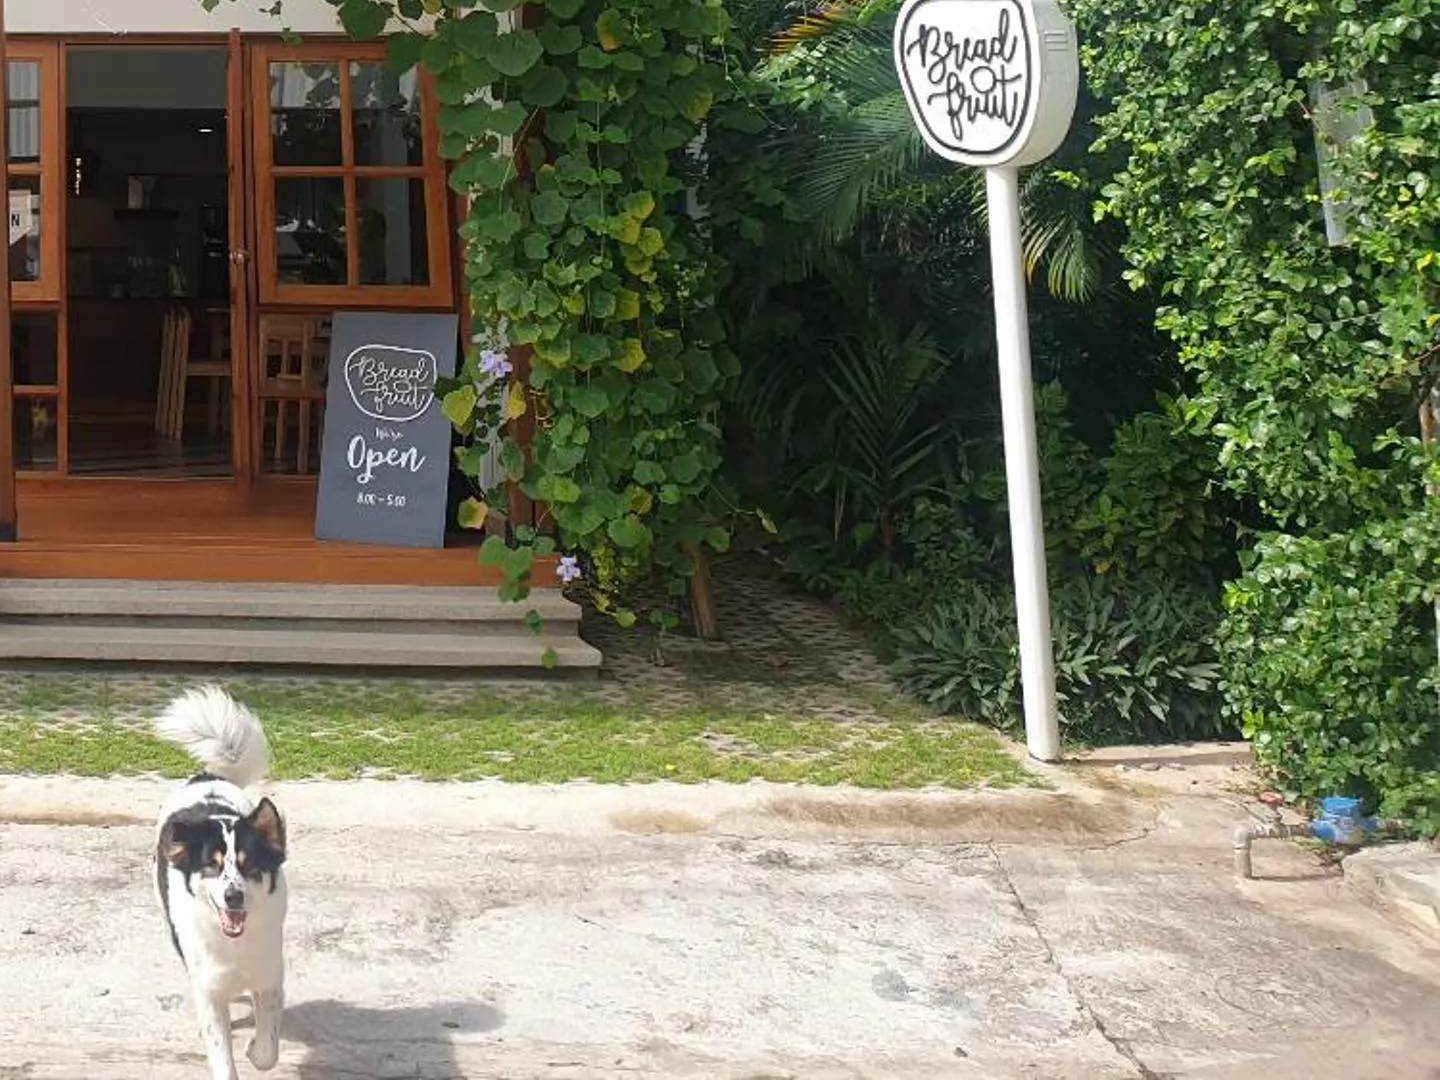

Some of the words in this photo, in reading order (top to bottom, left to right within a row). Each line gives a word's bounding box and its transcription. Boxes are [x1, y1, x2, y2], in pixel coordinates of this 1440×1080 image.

[906, 8, 1018, 84] Bread
[349, 356, 429, 386] Bread
[347, 434, 427, 484] Open
